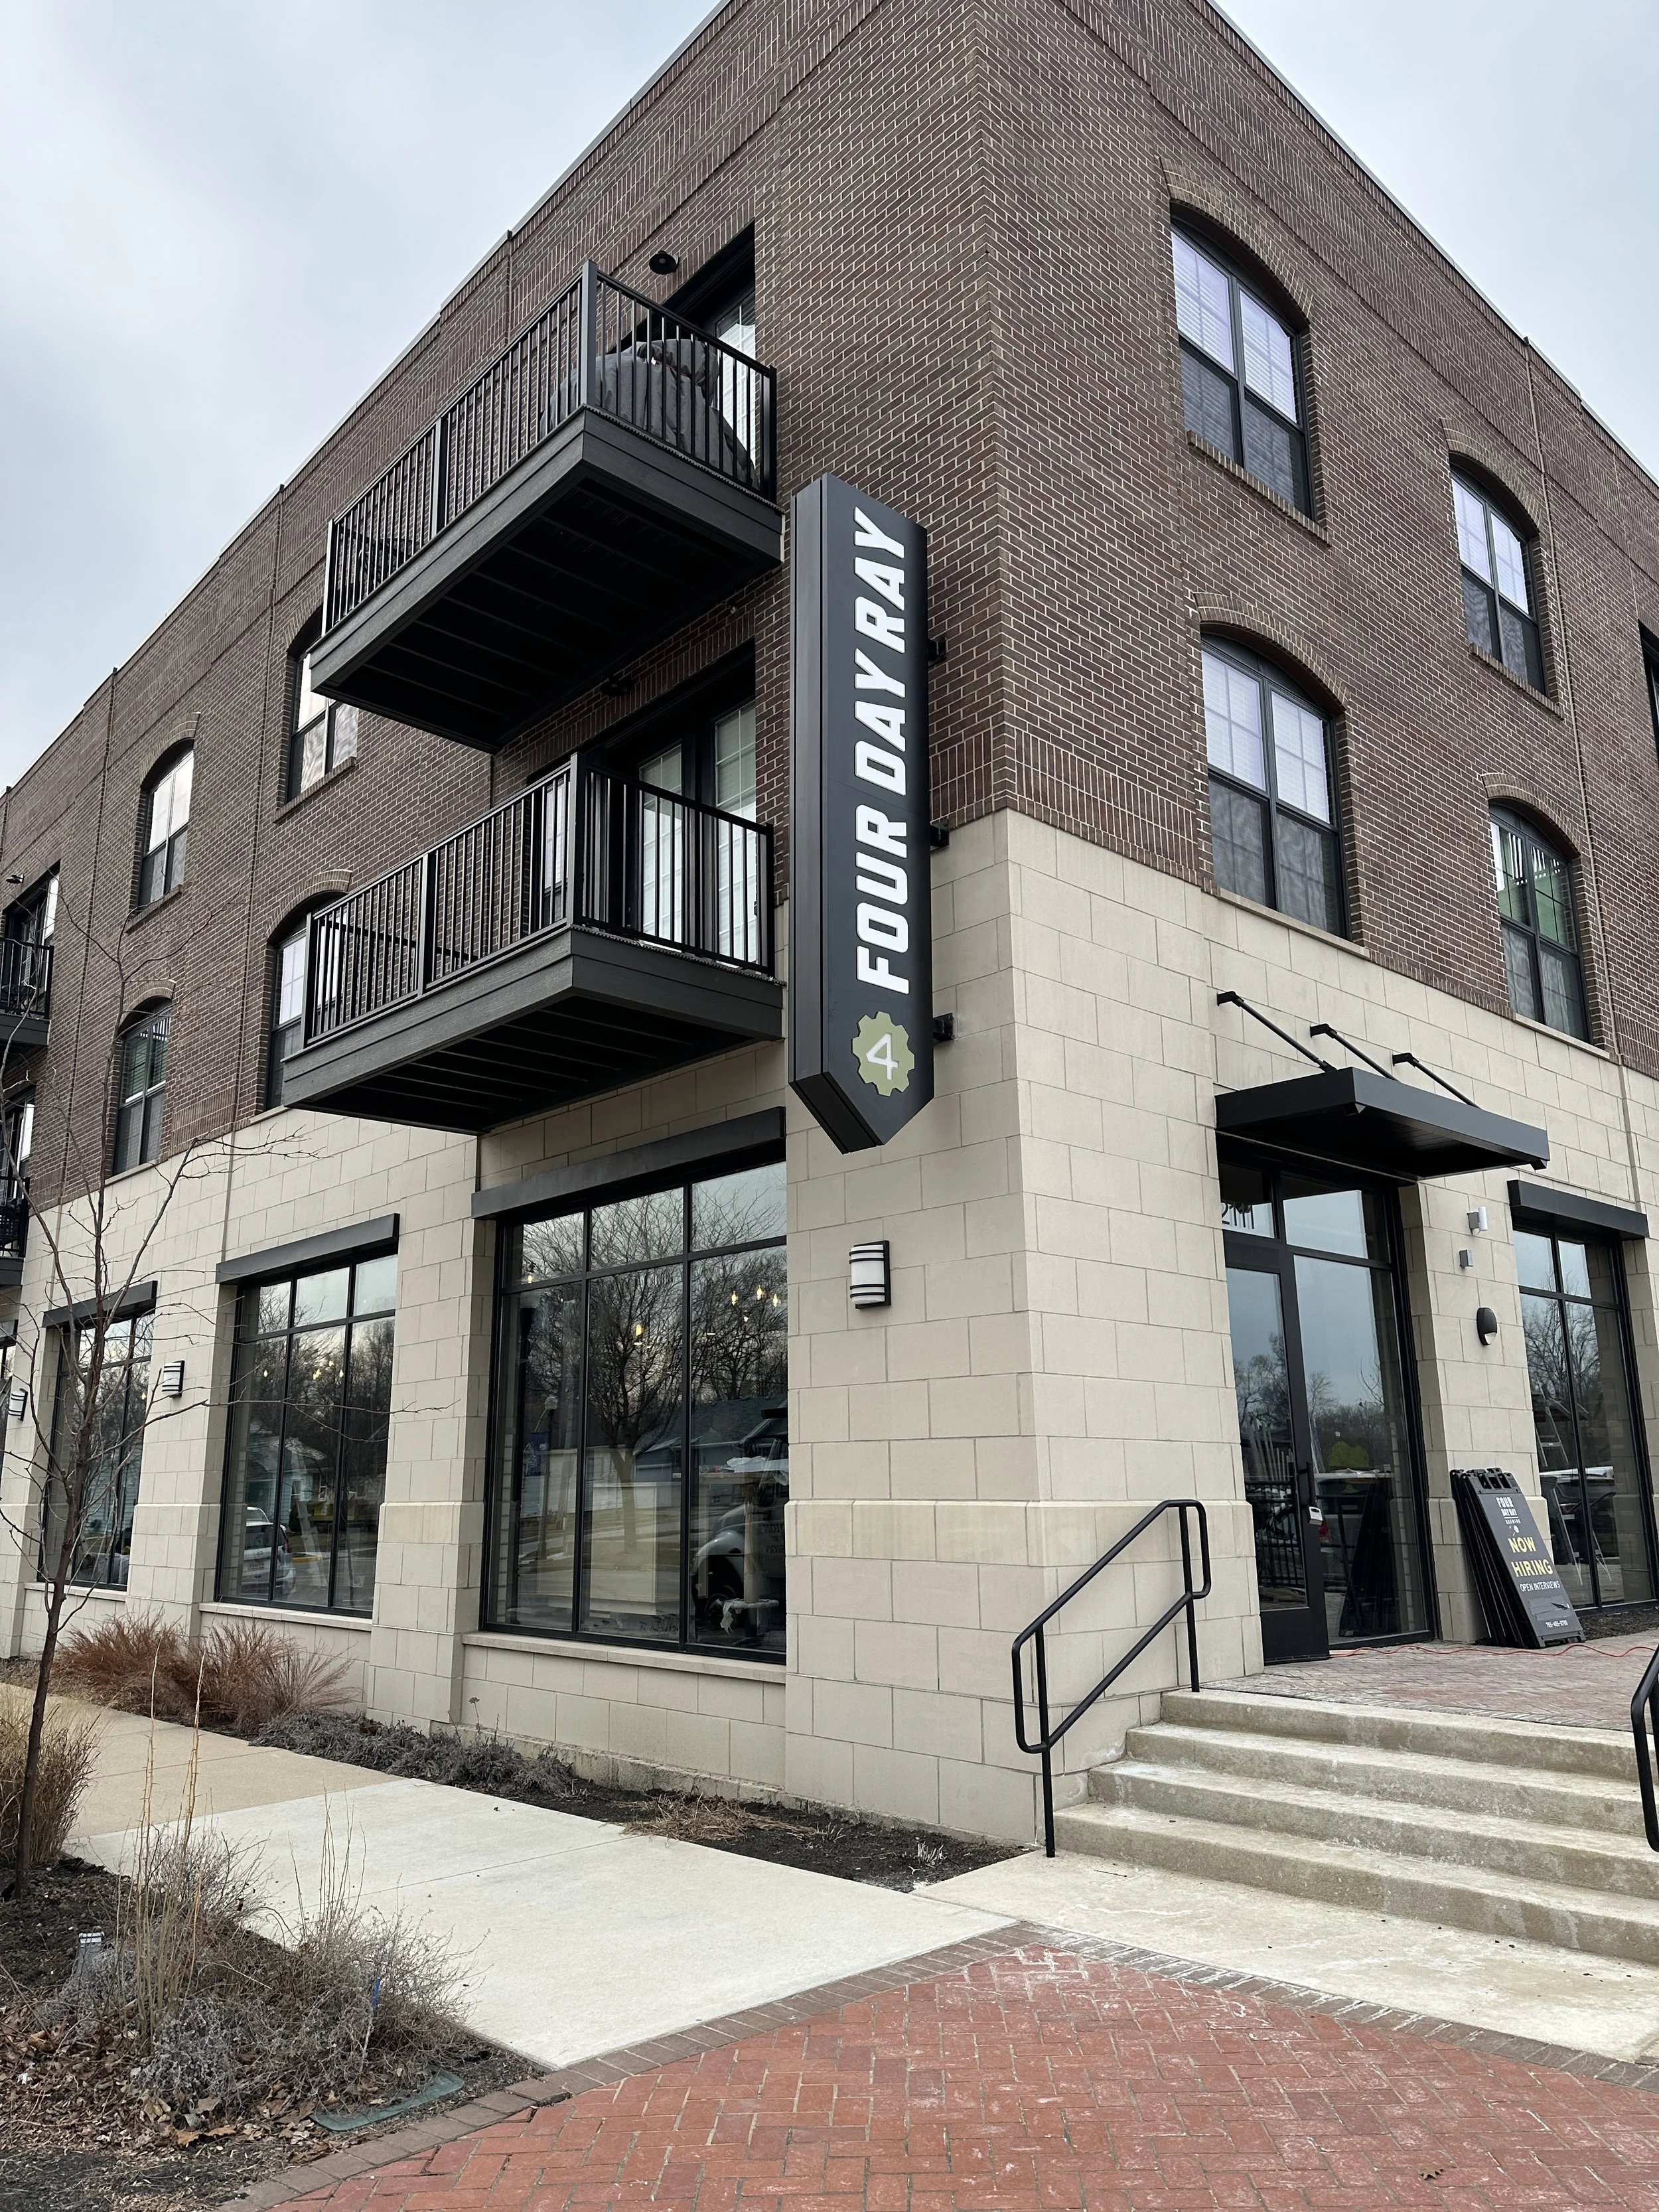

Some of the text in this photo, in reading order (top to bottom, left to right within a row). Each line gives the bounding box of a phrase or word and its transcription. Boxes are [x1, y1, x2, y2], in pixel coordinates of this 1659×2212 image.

[854, 506, 909, 994] FOUR DAY RAY
[865, 1033, 899, 1080] 4
[1496, 1497, 1514, 1507] FOUR
[1508, 1537, 1536, 1552] NOW
[1511, 1559, 1553, 1577] HIRING
[1520, 1580, 1561, 1592] OPEN INTERVIEWS
